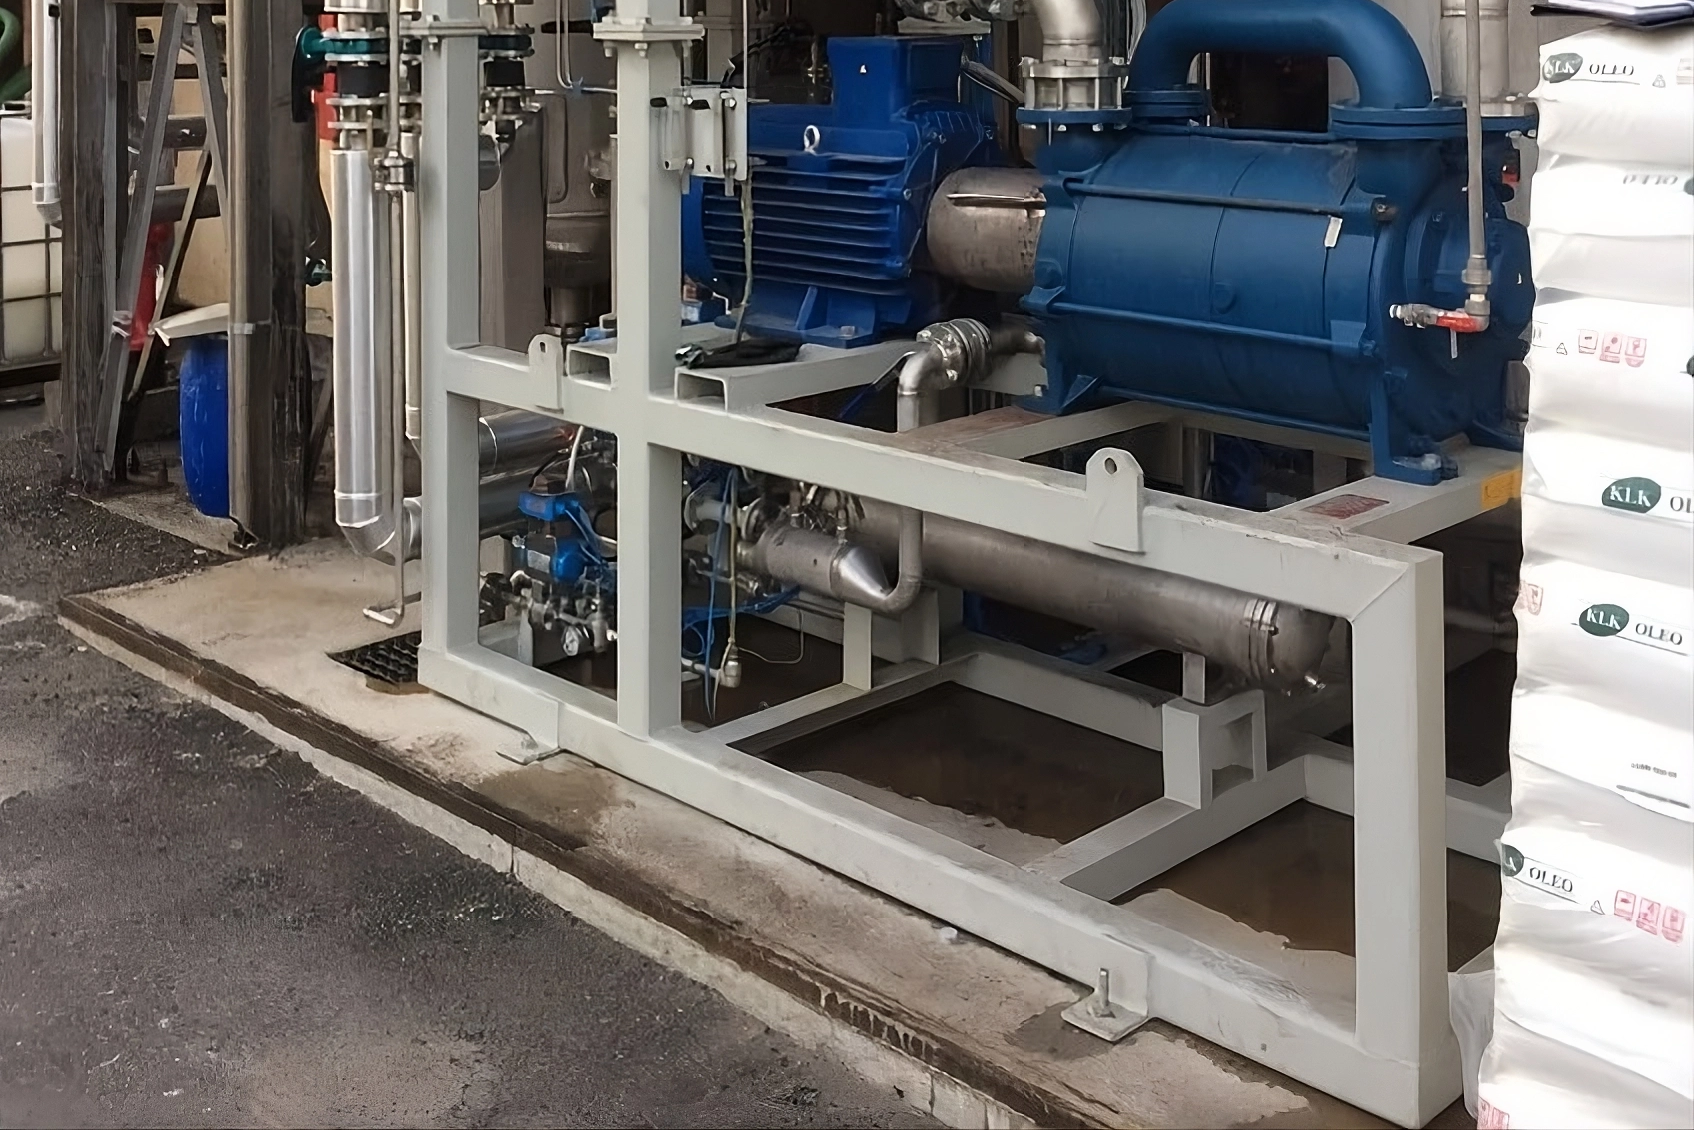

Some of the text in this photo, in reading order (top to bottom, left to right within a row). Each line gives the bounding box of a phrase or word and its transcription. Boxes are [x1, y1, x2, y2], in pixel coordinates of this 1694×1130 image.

[1610, 484, 1651, 507] KLK
[1586, 608, 1683, 645] KLK OLEO
[1529, 866, 1573, 893] OLEO
